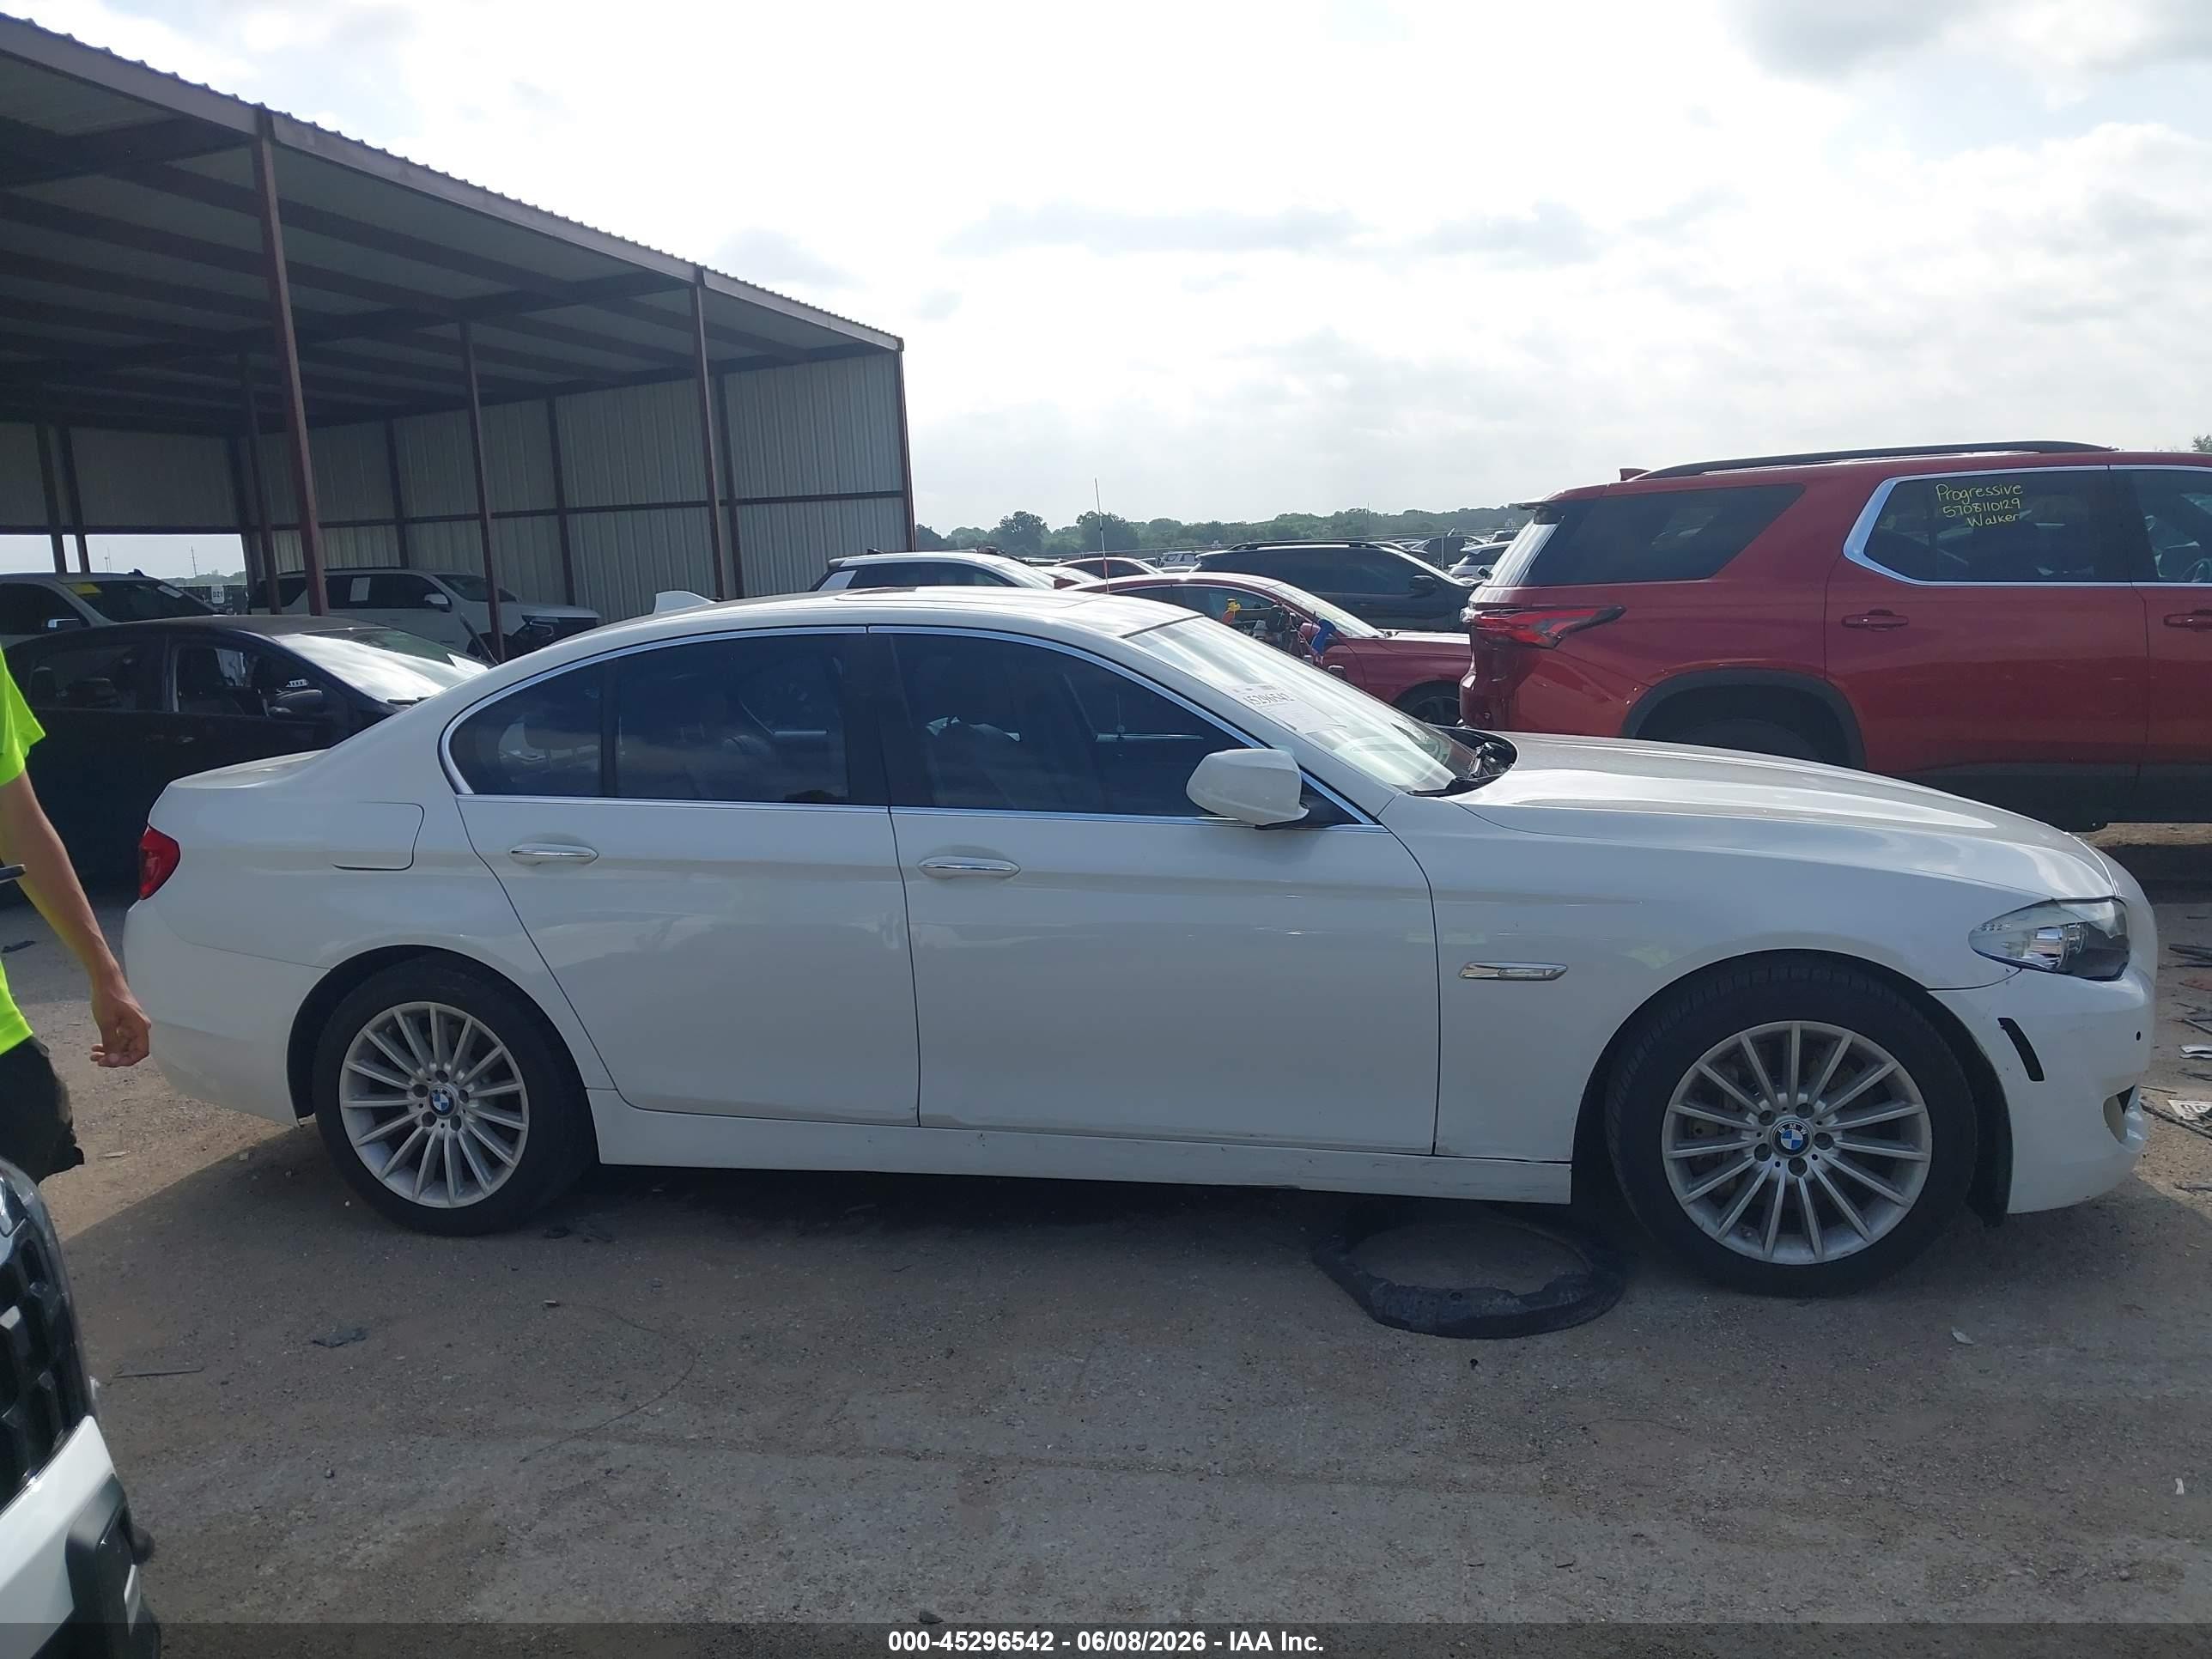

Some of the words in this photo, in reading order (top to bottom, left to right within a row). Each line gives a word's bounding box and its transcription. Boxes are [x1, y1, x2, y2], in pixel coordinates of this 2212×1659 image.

[1936, 483, 2023, 505] Progressive
[1942, 498, 2021, 518] 5708110129
[1966, 514, 2020, 526] Walker
[1778, 1122, 1808, 1135] BMW
